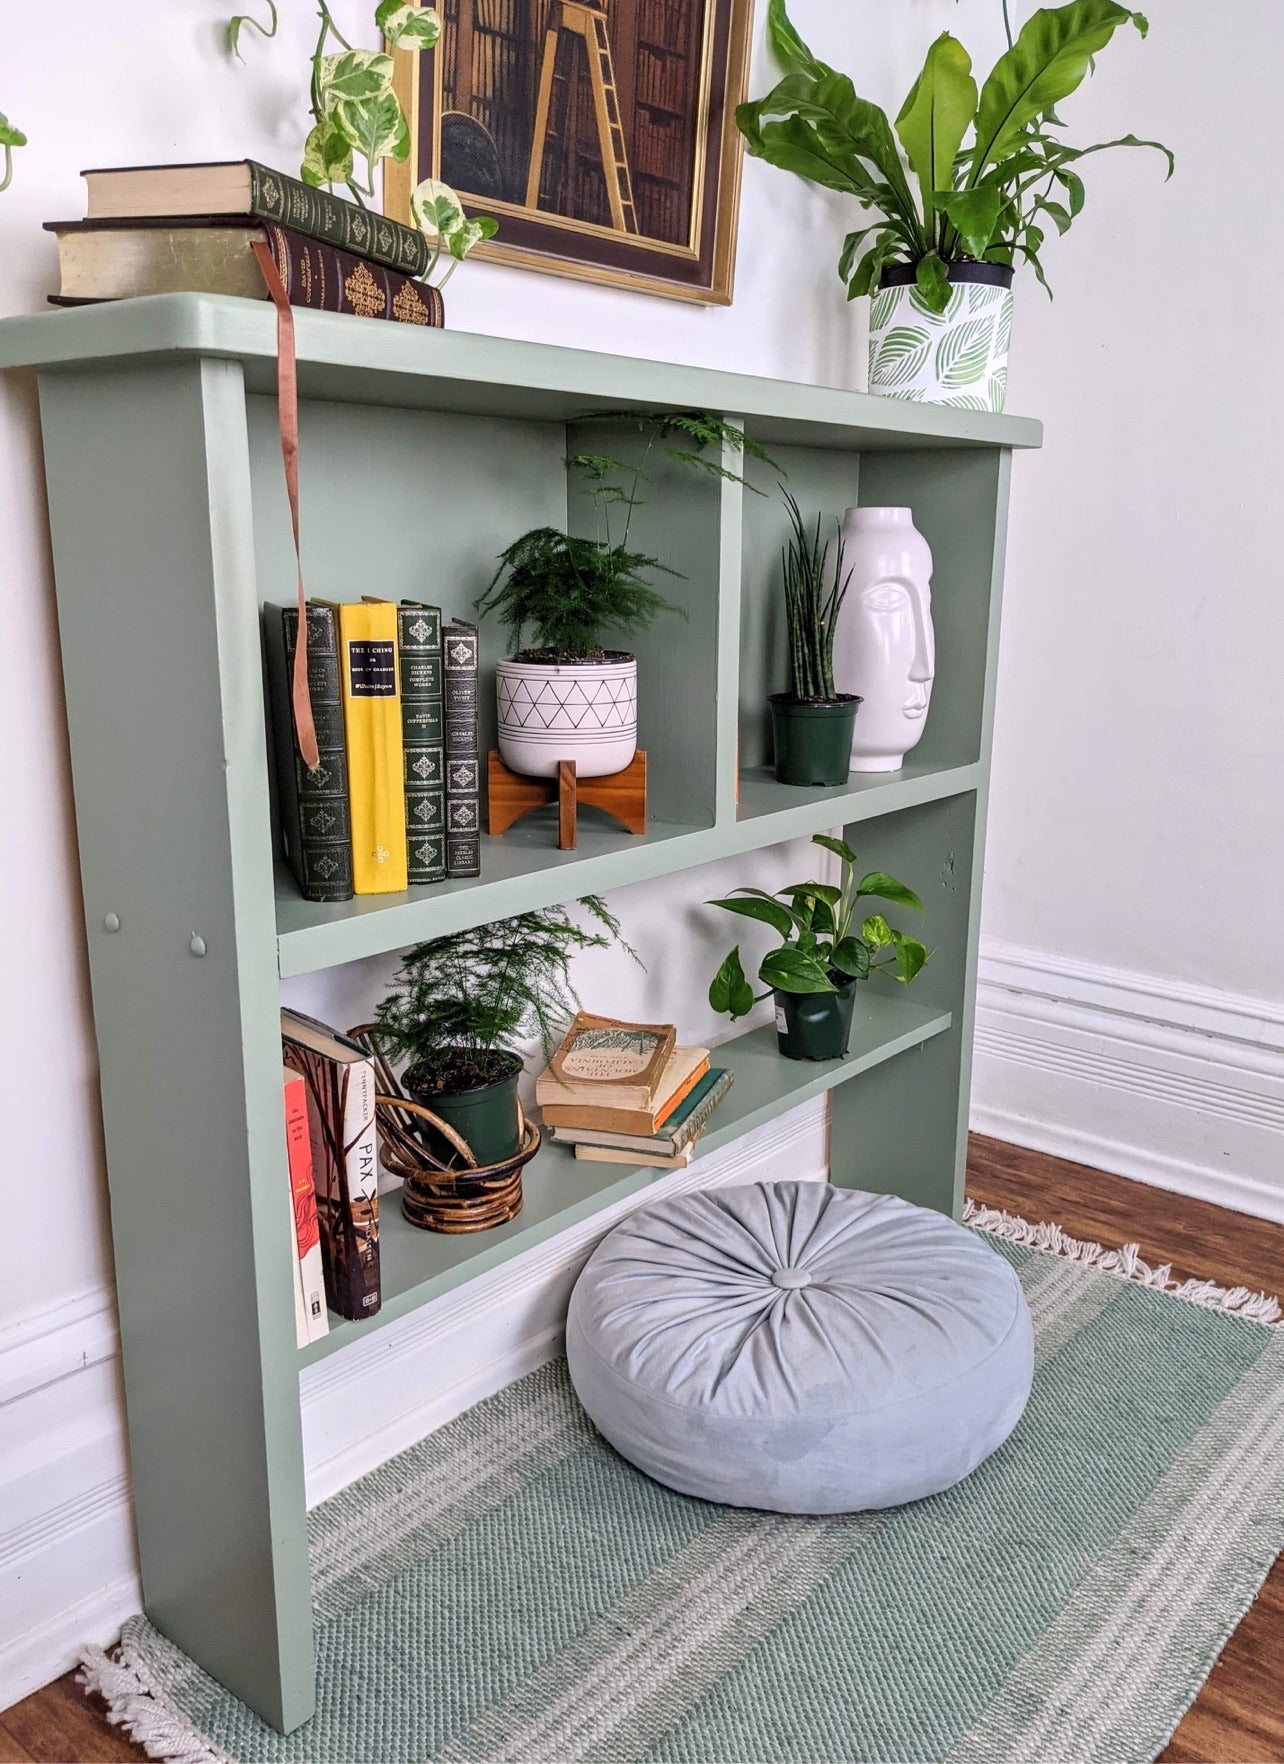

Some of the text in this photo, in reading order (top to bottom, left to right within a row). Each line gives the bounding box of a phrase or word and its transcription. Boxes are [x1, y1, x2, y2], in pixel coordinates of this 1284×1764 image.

[304, 246, 312, 303] COPPERFIELD
[361, 1070, 369, 1121] PENNYPACKER
[359, 1143, 373, 1181] PAX
